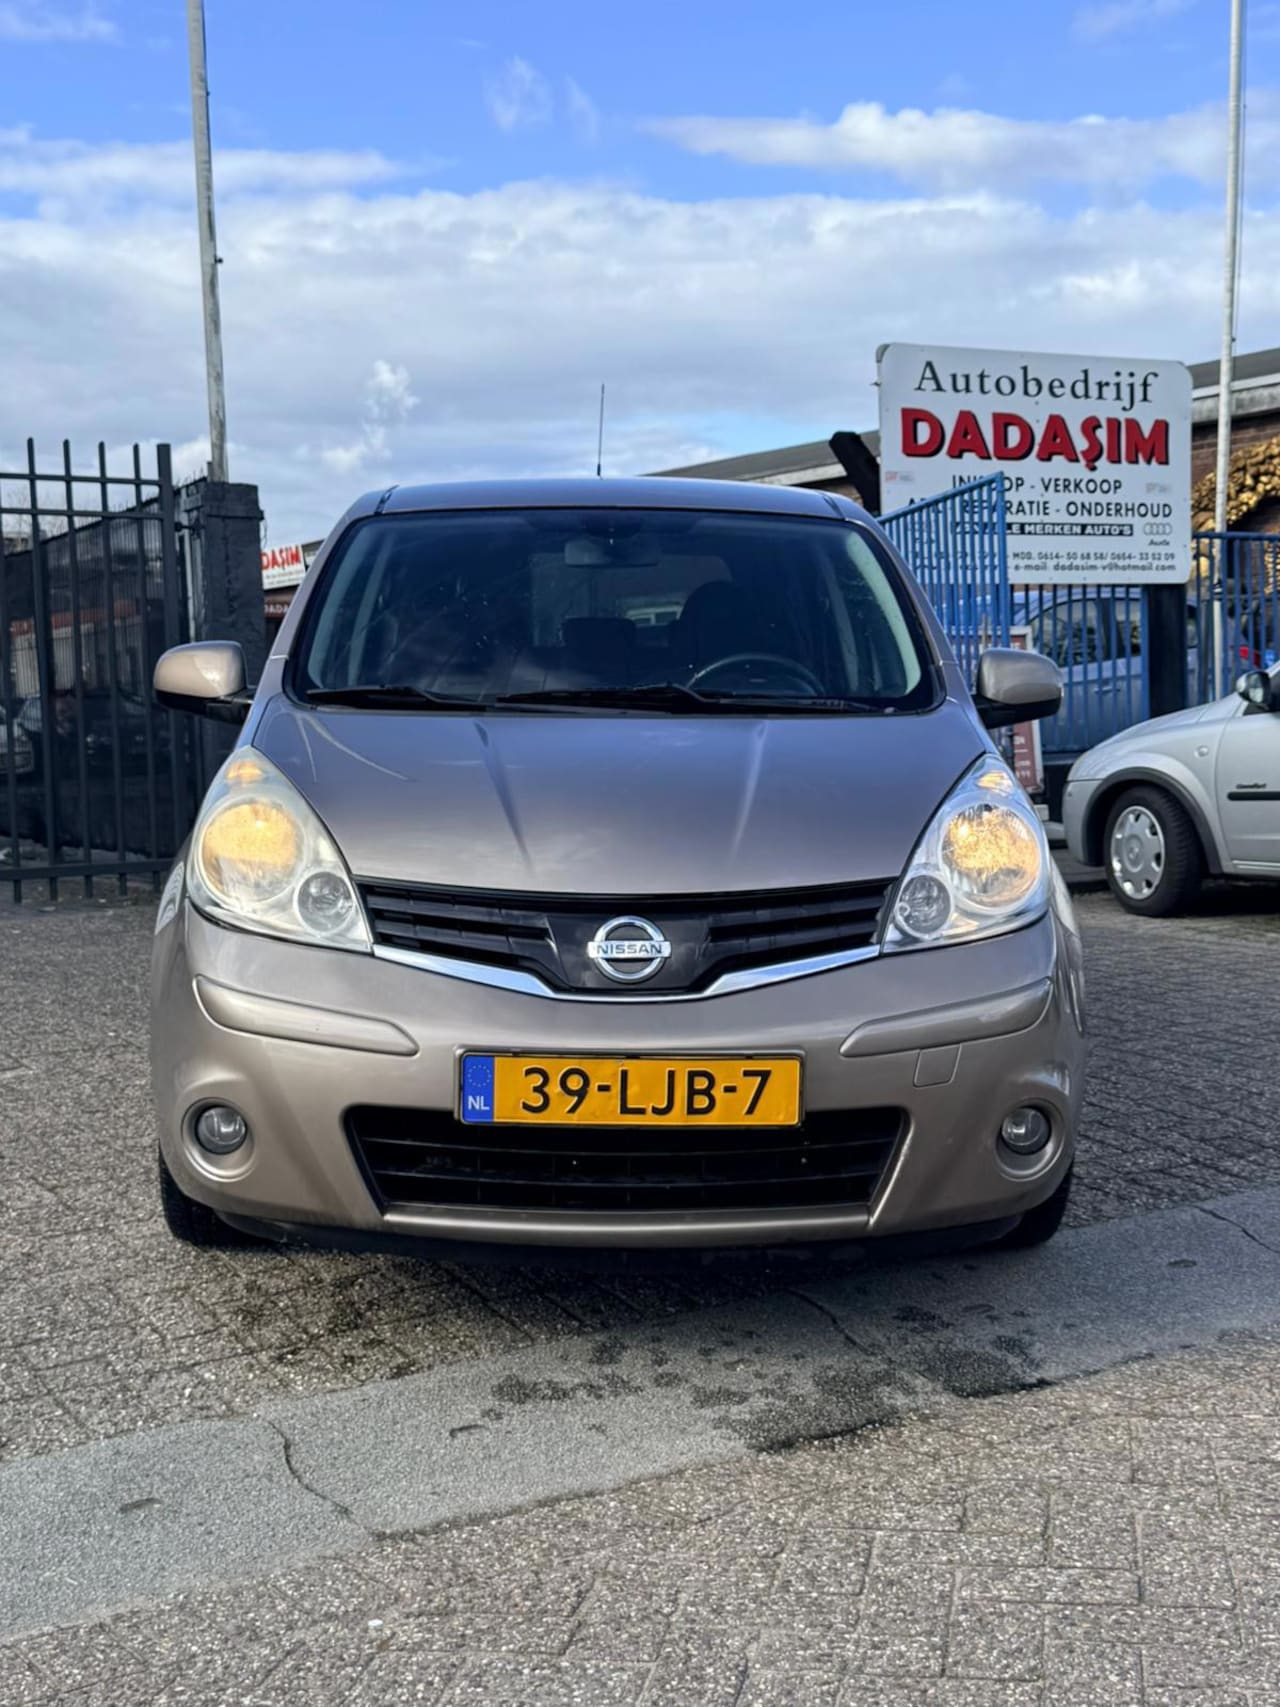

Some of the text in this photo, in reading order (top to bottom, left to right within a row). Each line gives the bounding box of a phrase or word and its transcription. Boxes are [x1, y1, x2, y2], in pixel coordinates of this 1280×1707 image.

[914, 361, 1158, 411] Autobedrijf
[901, 408, 1170, 471] DADAŞIM
[1040, 477, 1123, 494] VERKOOP
[1065, 501, 1173, 518] ONDERHOUD
[1023, 524, 1082, 535] MERKEN
[1084, 525, 1132, 536] AUTO'S
[596, 944, 663, 955] NISSAN
[468, 1066, 773, 1116] NL 39-LJB-7
